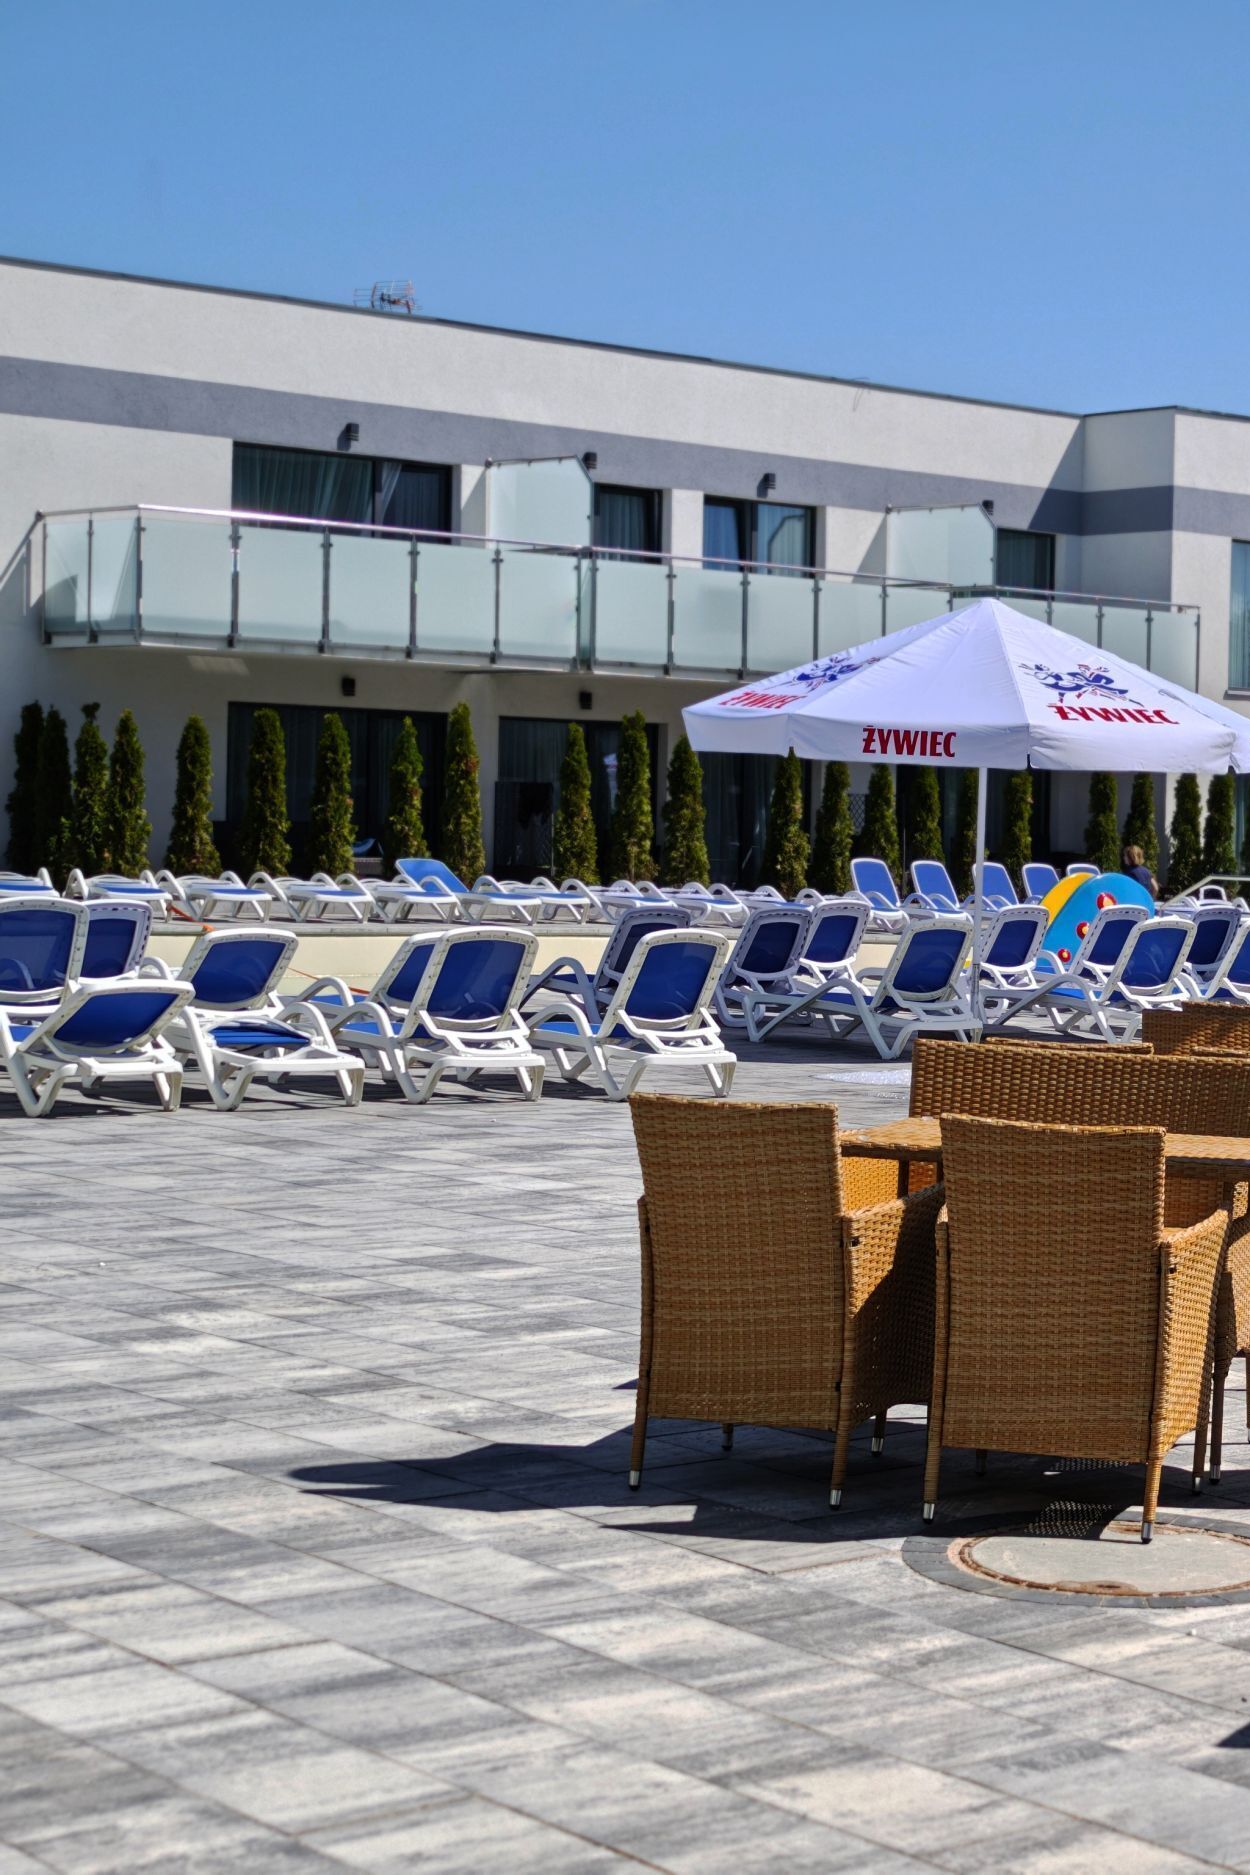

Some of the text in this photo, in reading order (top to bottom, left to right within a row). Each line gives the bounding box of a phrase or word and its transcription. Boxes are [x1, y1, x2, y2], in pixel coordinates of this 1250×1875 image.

[719, 690, 808, 709] ŻYWIEC
[1048, 703, 1180, 725] ŻYWIEC
[862, 725, 957, 758] ŻYWIEC
